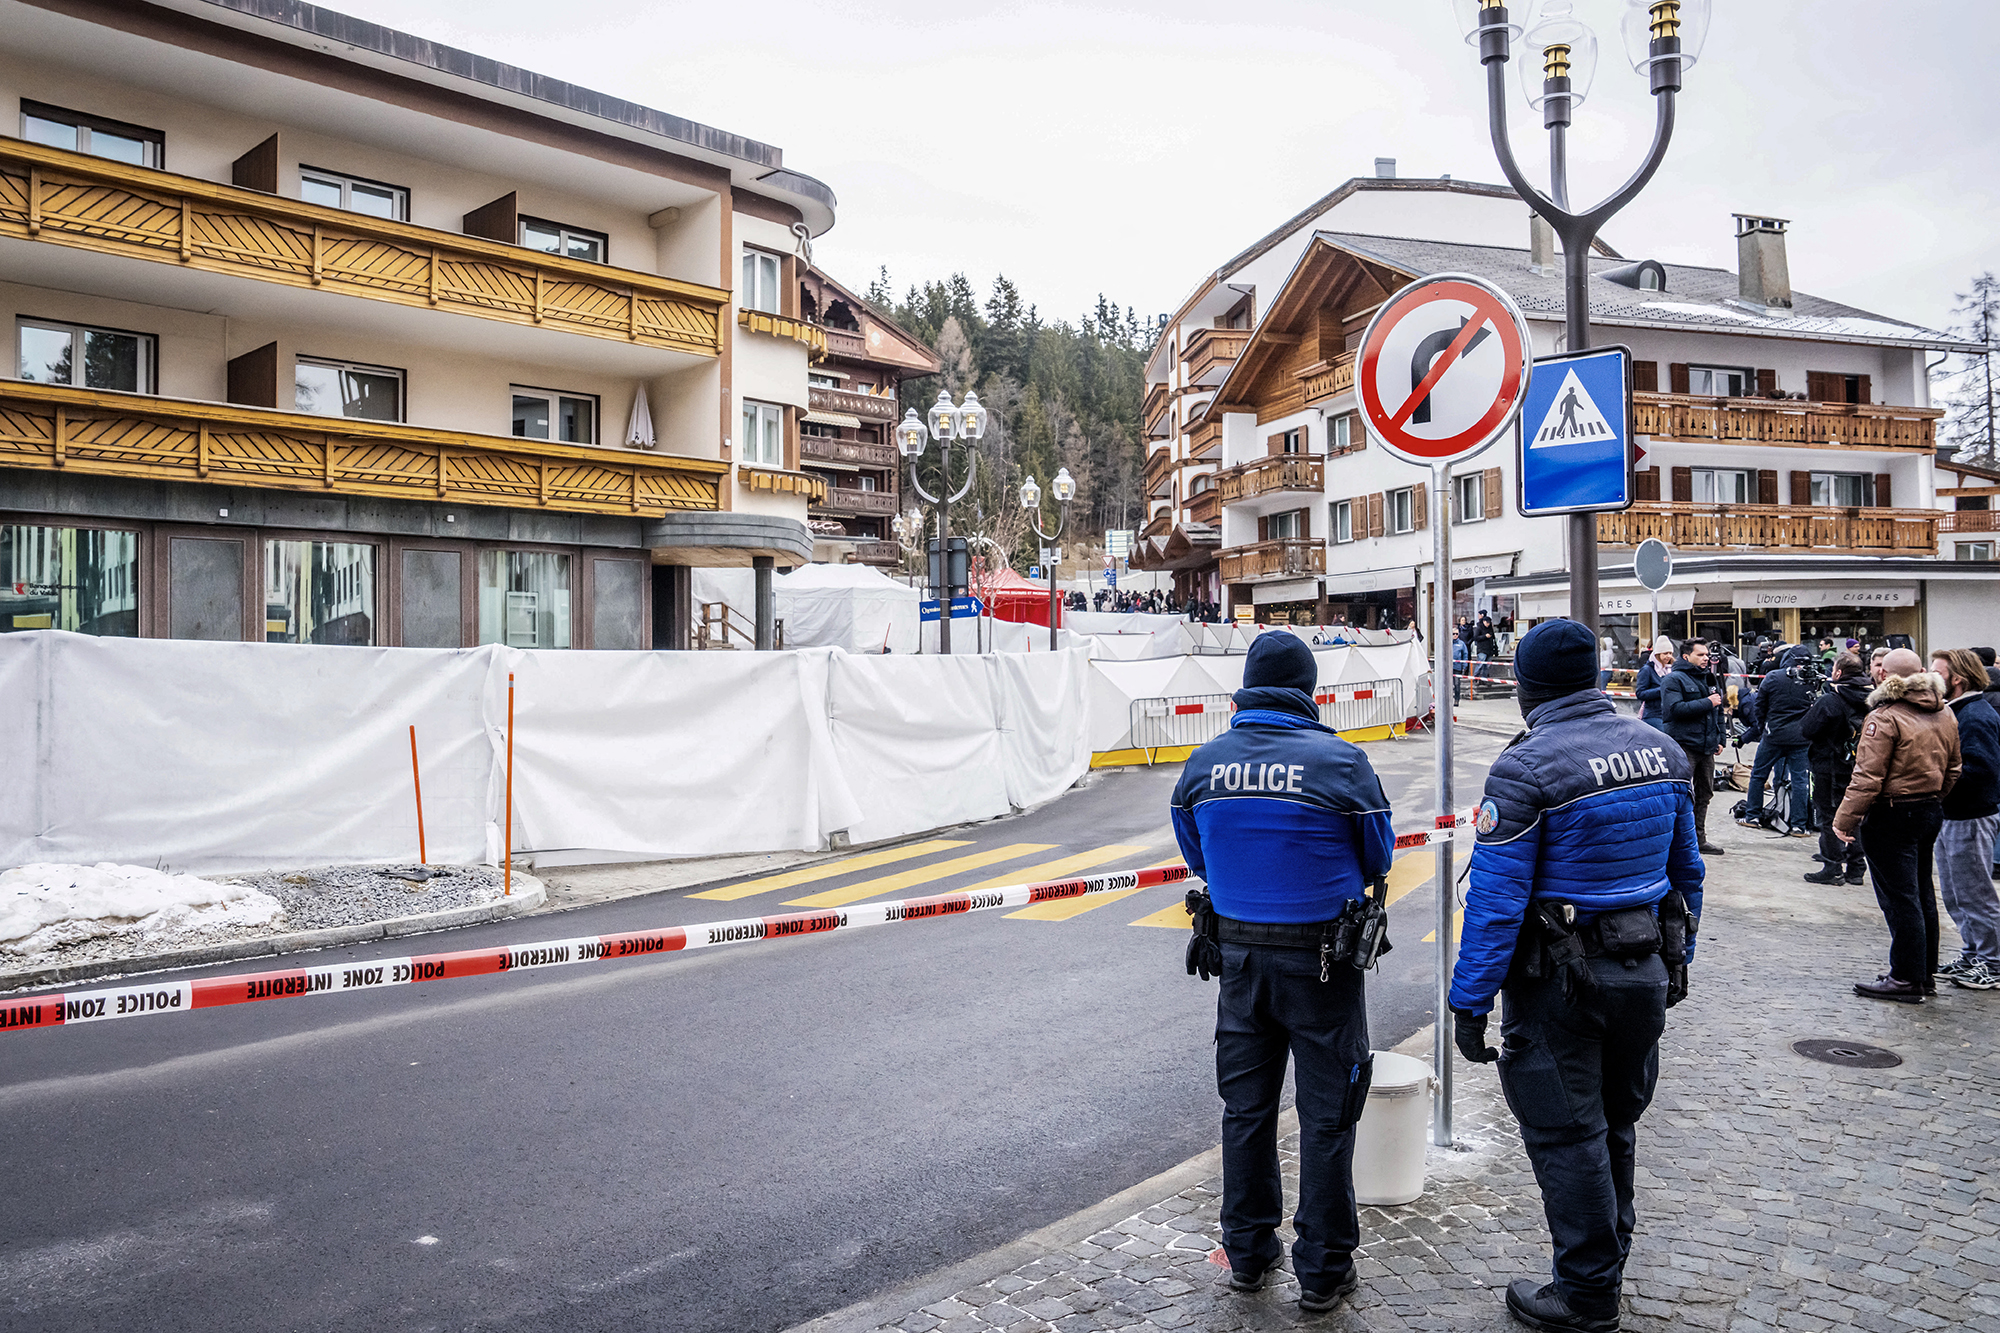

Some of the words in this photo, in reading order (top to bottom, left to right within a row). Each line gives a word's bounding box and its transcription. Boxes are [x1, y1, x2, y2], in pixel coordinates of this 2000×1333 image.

[1474, 565, 1493, 574] Crans
[1599, 599, 1633, 609] ARES
[1757, 593, 1797, 604] Librairie
[1843, 593, 1900, 601] CIGARES
[1588, 747, 1669, 786] POLICE
[1210, 763, 1304, 792] POLICE
[1108, 875, 1136, 889] POLICE
[1162, 867, 1197, 882] TERDITE
[1035, 882, 1079, 899] INTERDITE
[1083, 879, 1104, 894] ZONE
[941, 898, 966, 913] ZONE
[971, 893, 1004, 909] POLICE
[885, 901, 936, 921] INTERDITE
[775, 918, 804, 935] ZONE
[810, 913, 848, 932] POLICE
[708, 923, 768, 944] INTERDITE
[578, 941, 612, 960] ZONE
[620, 935, 664, 955] POLICE
[499, 946, 569, 970] INTERDITE
[343, 967, 384, 988] ZONE
[393, 960, 445, 983] POLICE
[247, 973, 332, 998] INTERDITE
[55, 997, 107, 1022] ZONE
[117, 989, 182, 1014] POLICE
